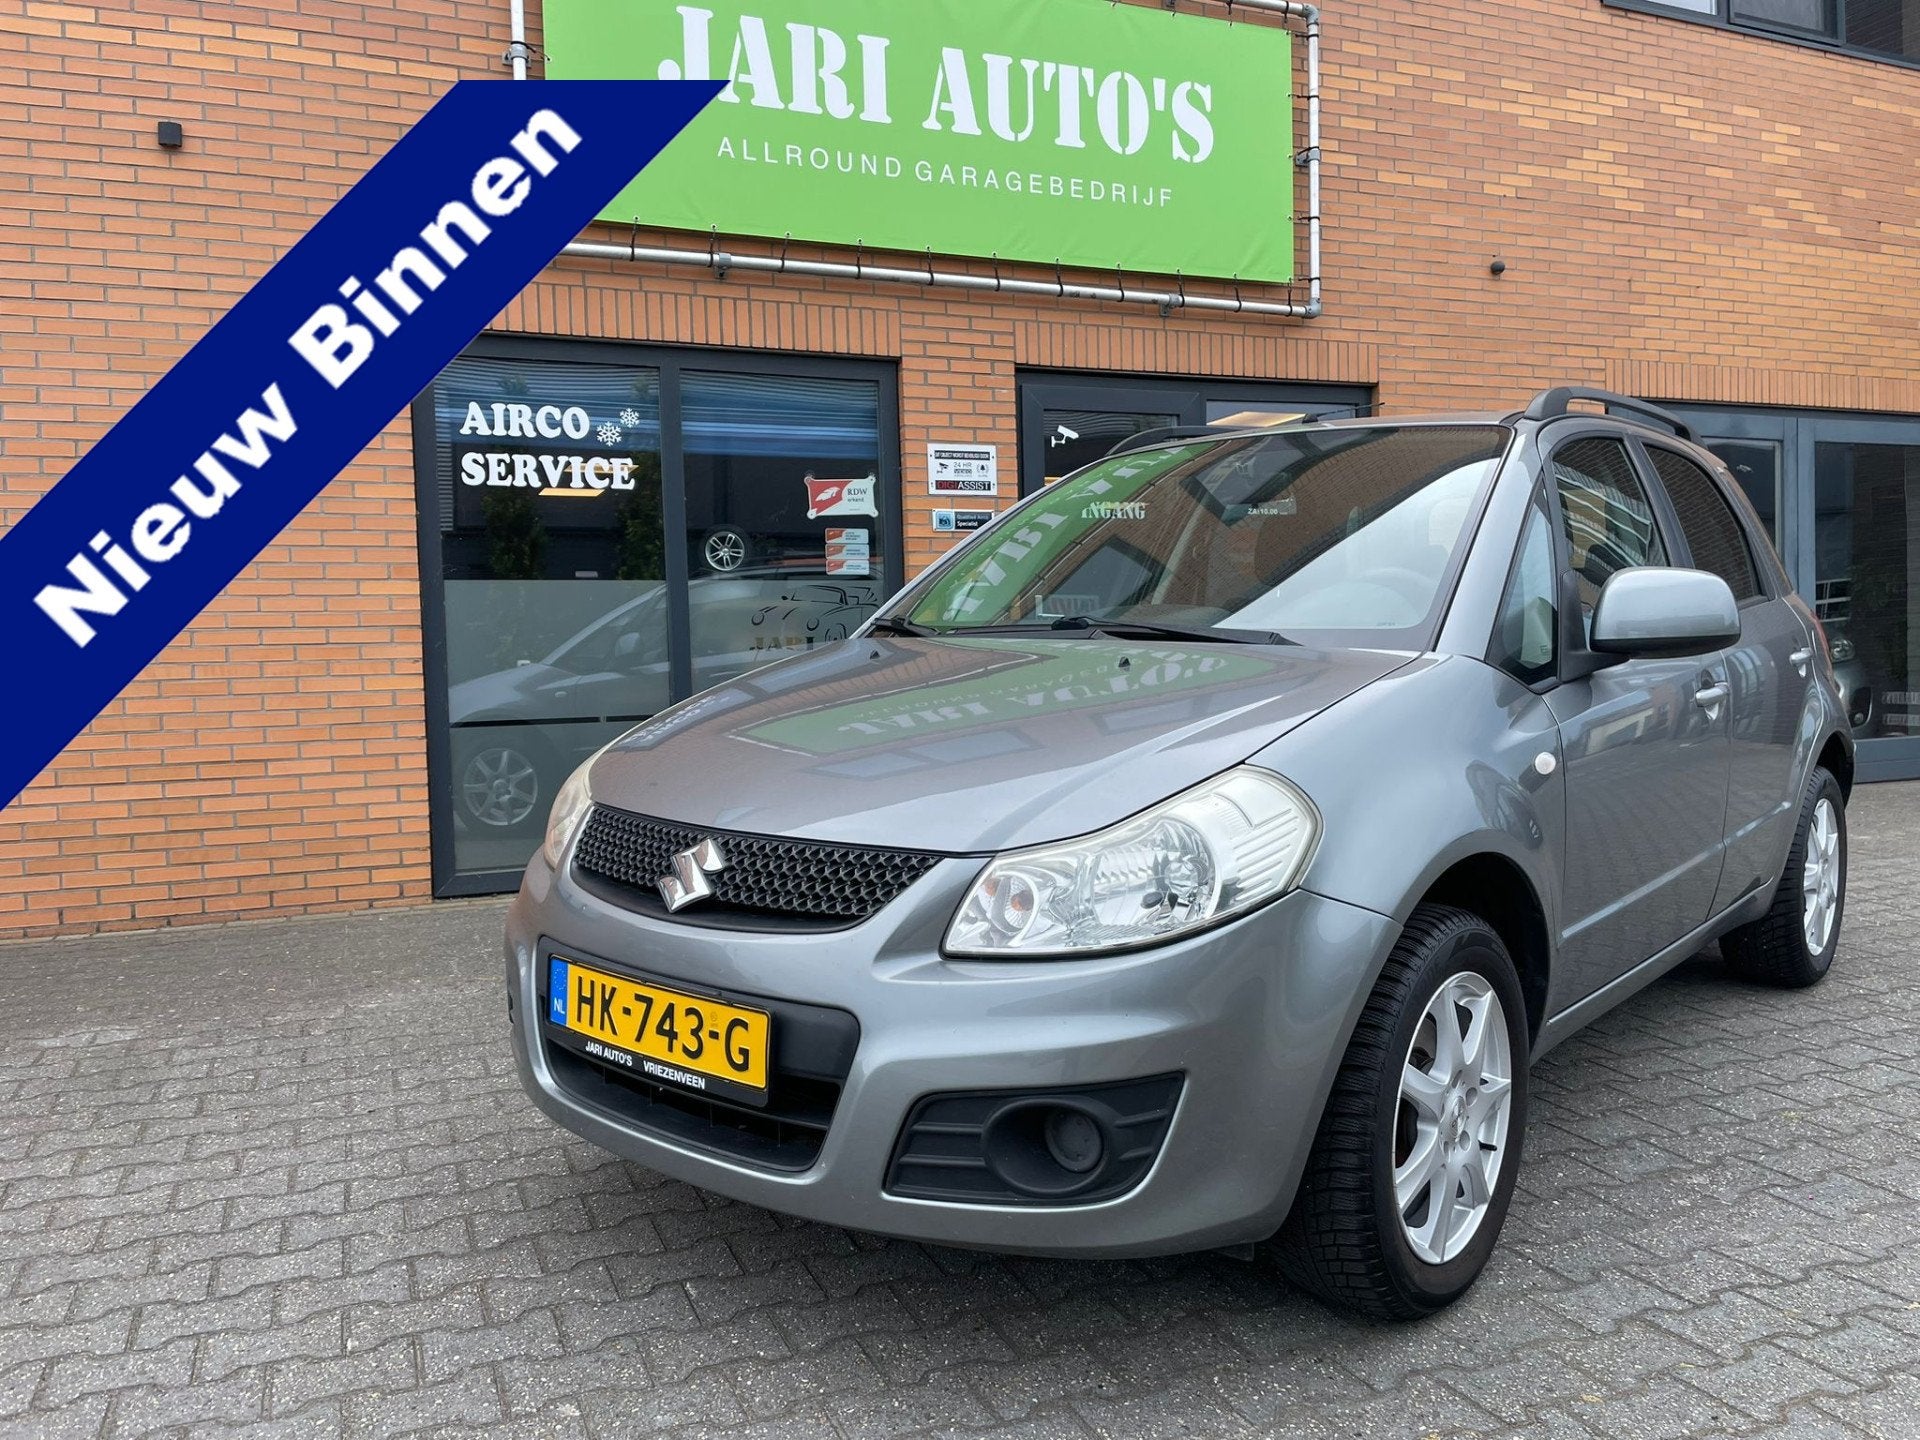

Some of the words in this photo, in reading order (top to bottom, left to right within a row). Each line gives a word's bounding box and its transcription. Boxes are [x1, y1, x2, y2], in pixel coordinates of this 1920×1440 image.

[658, 5, 892, 124] JARI
[923, 46, 1214, 164] AUTO'S
[717, 136, 901, 177] ALLROUND
[915, 161, 1174, 208] GARAGEBEDRIJF
[459, 401, 590, 440] AIRCO
[461, 451, 636, 490] SERVICE
[937, 481, 990, 490] DIGIASSIST
[847, 488, 868, 496] RDW
[553, 997, 566, 1015] NL
[576, 975, 750, 1073] HK-743-G
[585, 1040, 603, 1057] JARI
[603, 1046, 633, 1067] AUTO'S
[643, 1060, 706, 1090] VRIEZENVEEN
